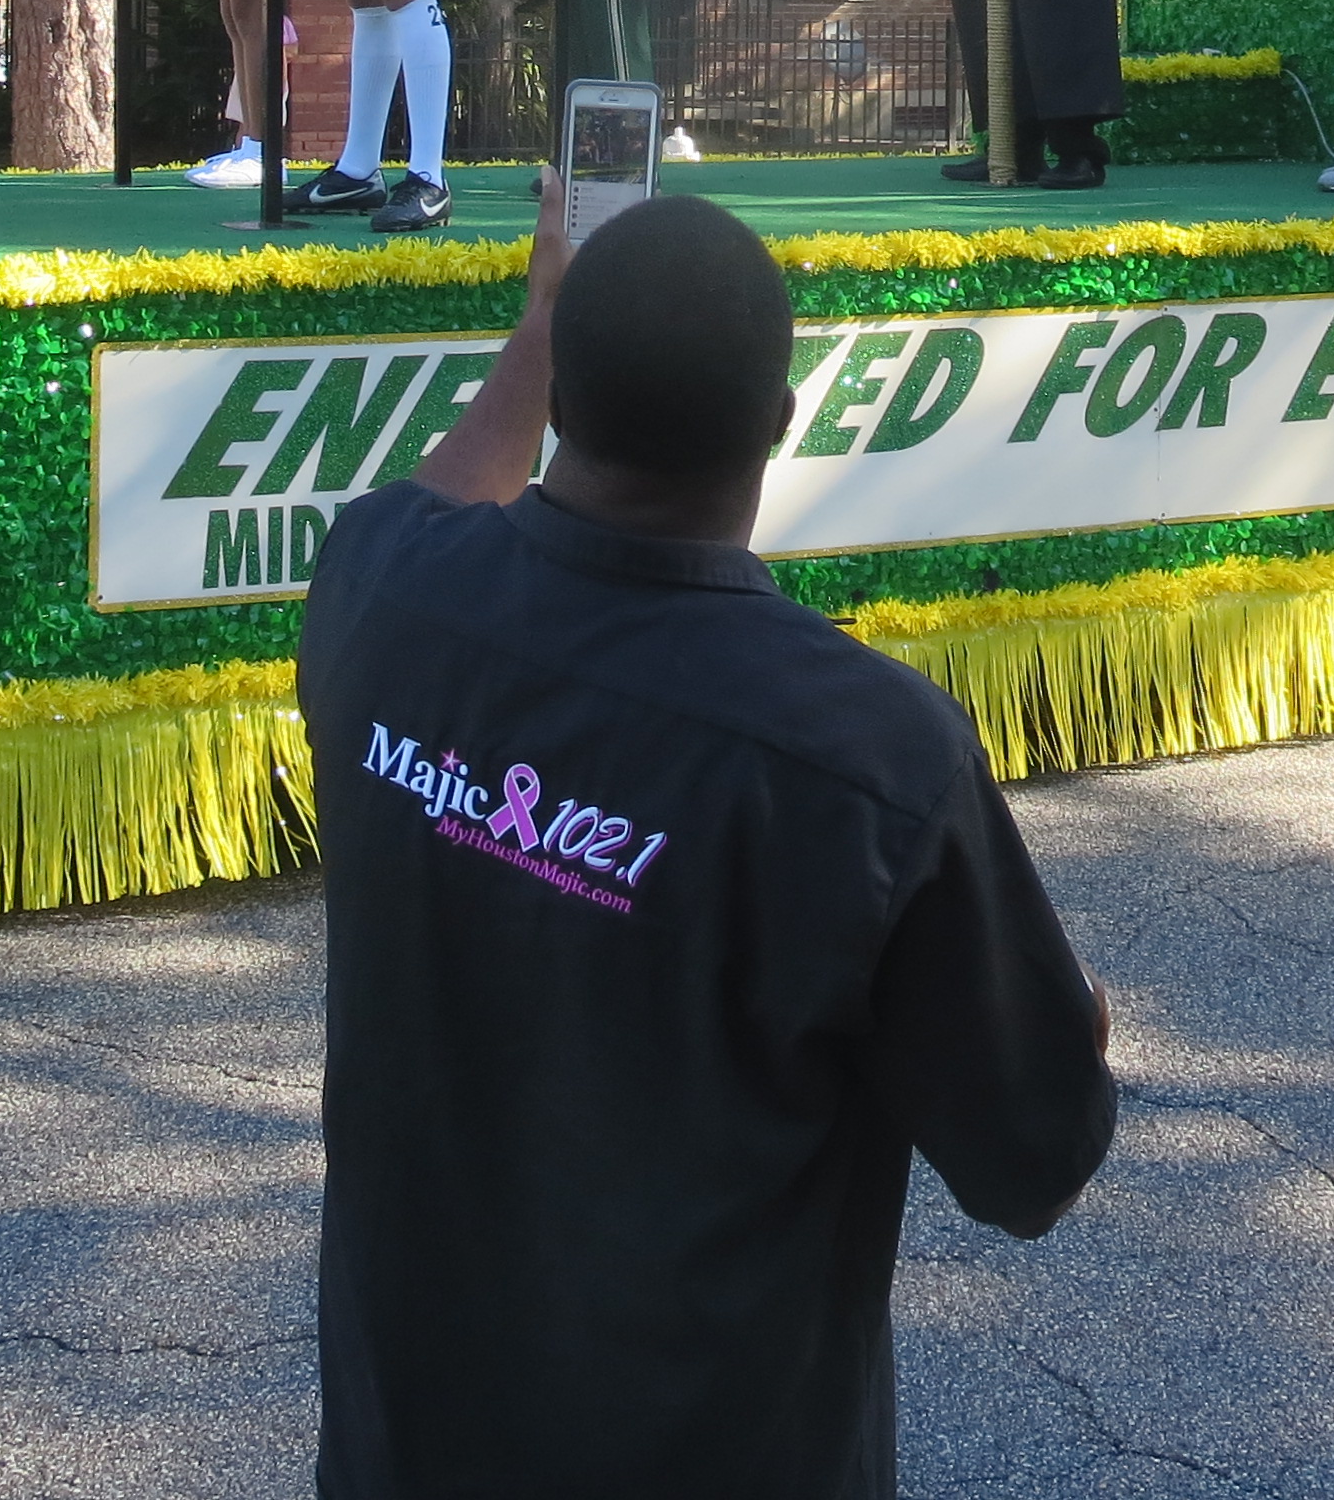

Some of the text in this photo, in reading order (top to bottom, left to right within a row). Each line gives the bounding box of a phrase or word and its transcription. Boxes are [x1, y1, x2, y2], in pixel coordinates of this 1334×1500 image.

[162, 327, 985, 500] ENEZED
[1007, 311, 1267, 444] FOR
[202, 501, 350, 590] MID
[362, 721, 667, 887] Majic 102.1
[435, 814, 632, 914] MyHoustonMajic.com
